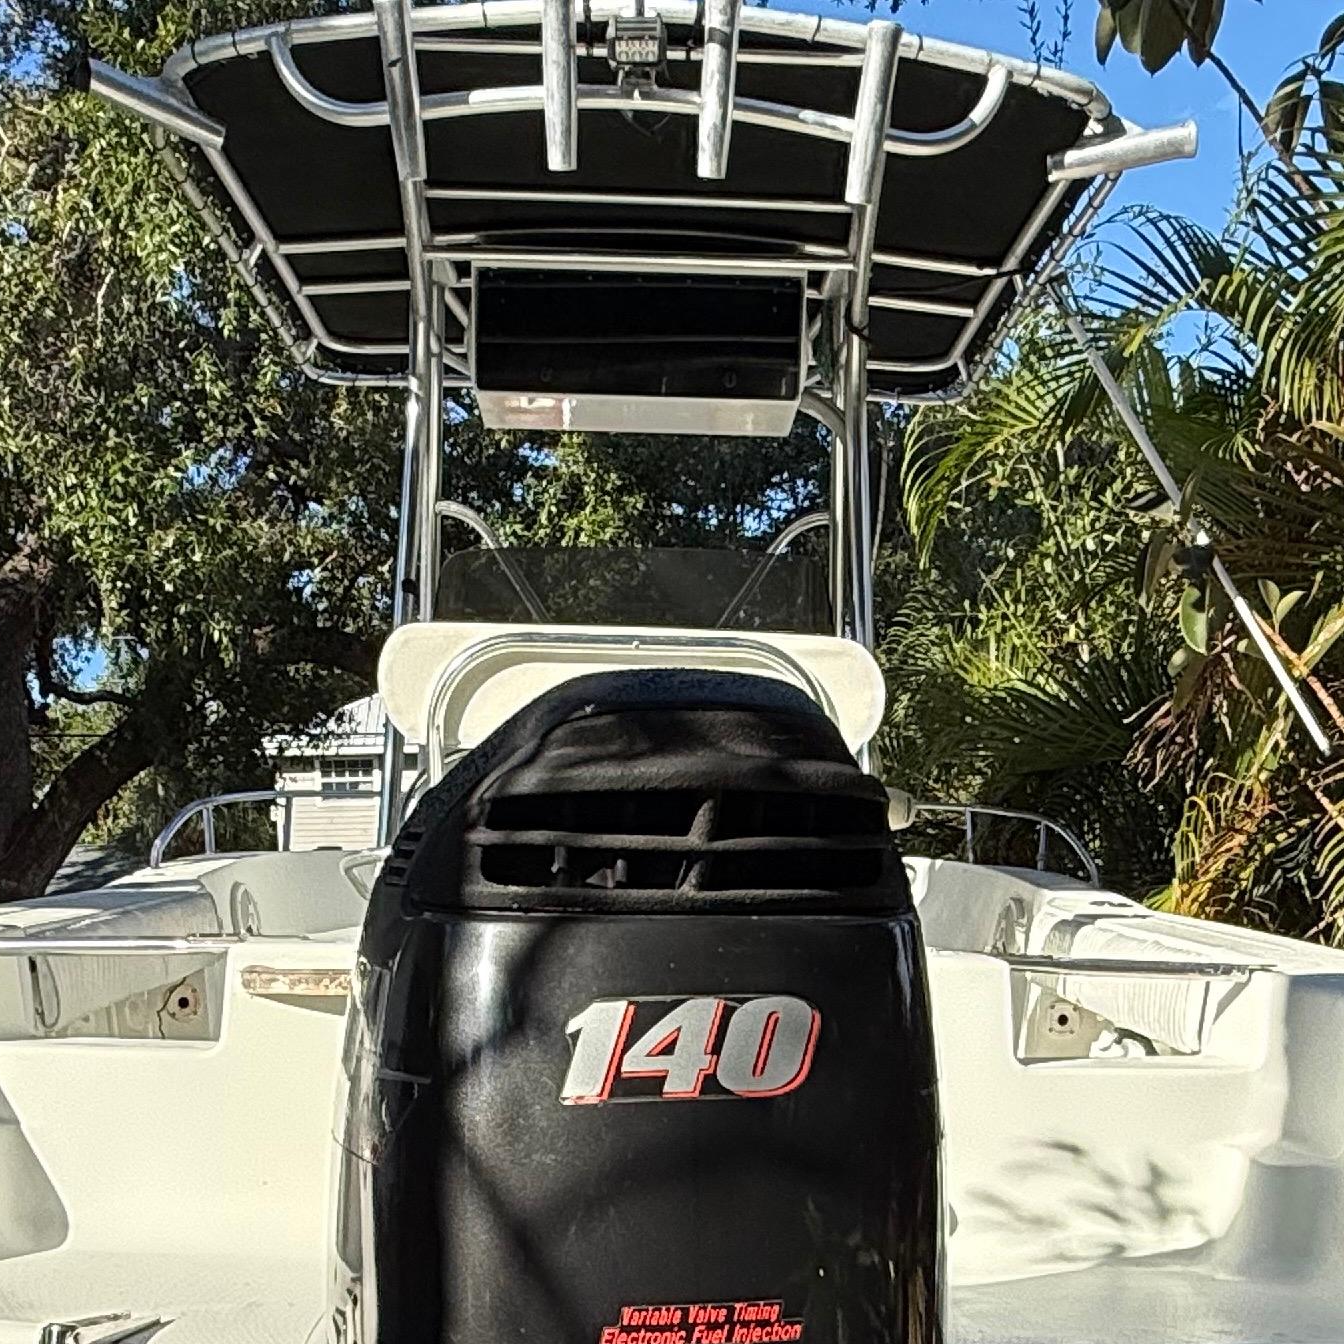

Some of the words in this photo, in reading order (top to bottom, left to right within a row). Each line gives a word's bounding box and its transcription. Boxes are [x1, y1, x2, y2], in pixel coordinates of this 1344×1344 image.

[560, 996, 821, 1105] 140
[622, 1306, 682, 1326] Variable
[688, 1304, 727, 1324] Valve
[733, 1302, 780, 1323] Timing
